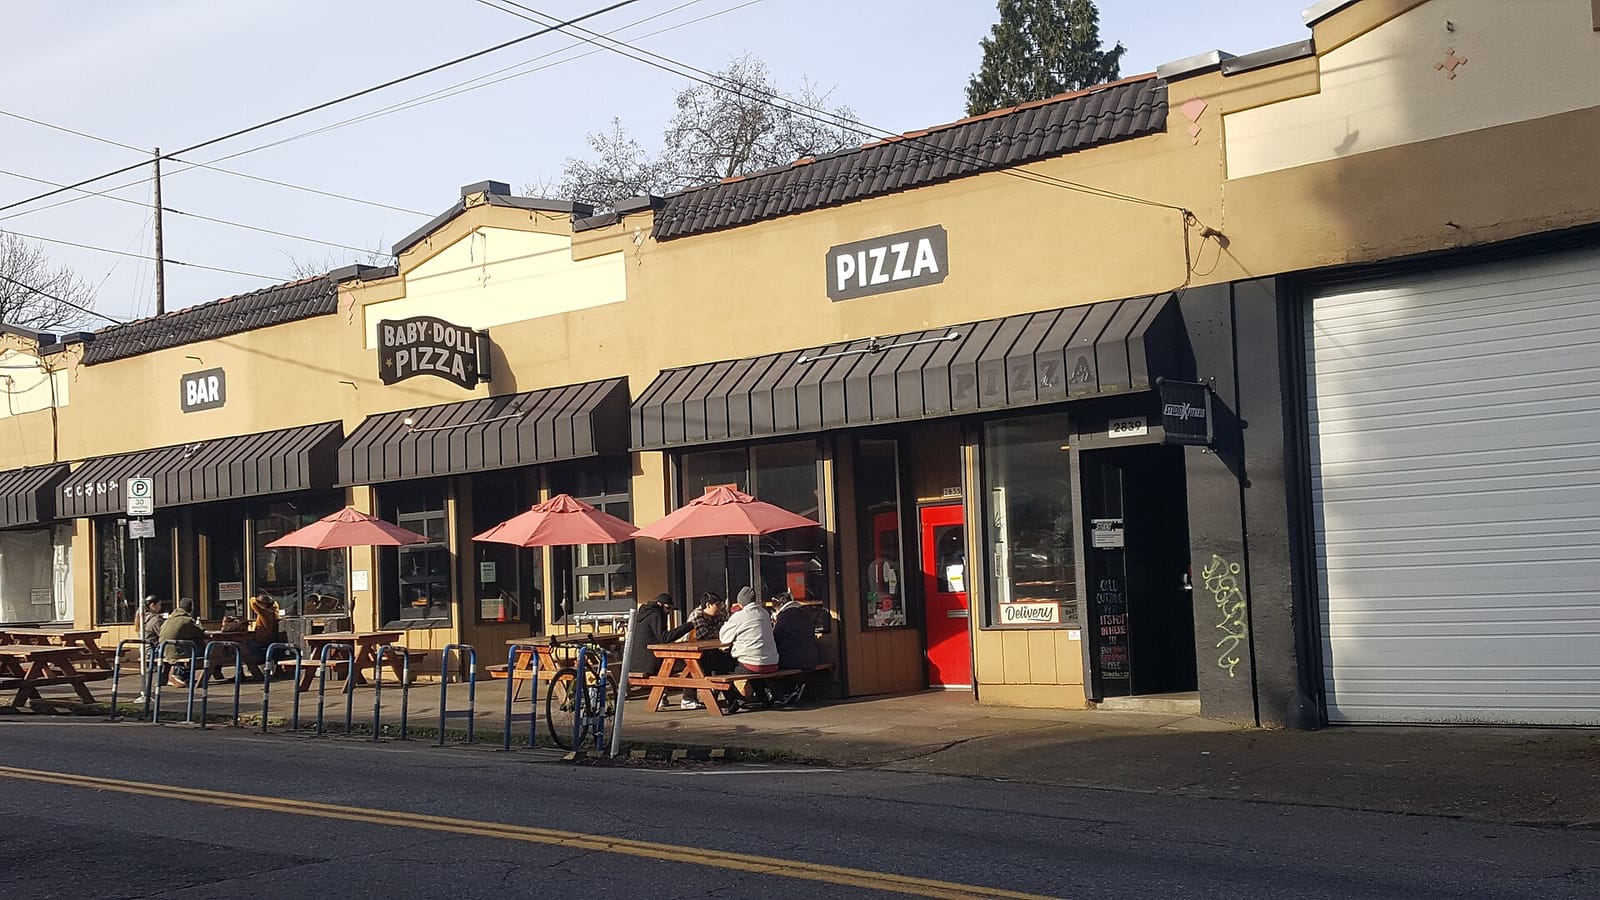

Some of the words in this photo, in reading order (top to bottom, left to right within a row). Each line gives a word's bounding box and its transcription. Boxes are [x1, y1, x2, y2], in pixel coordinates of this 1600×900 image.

[836, 238, 939, 291] PIZZA
[384, 321, 428, 347] BABY
[433, 322, 474, 354] DOLL
[395, 346, 467, 382] PIZZA
[954, 355, 1095, 400] PIZZA
[186, 375, 220, 406] BAR
[1113, 420, 1142, 433] 2839
[1005, 606, 1054, 622] Delivery
